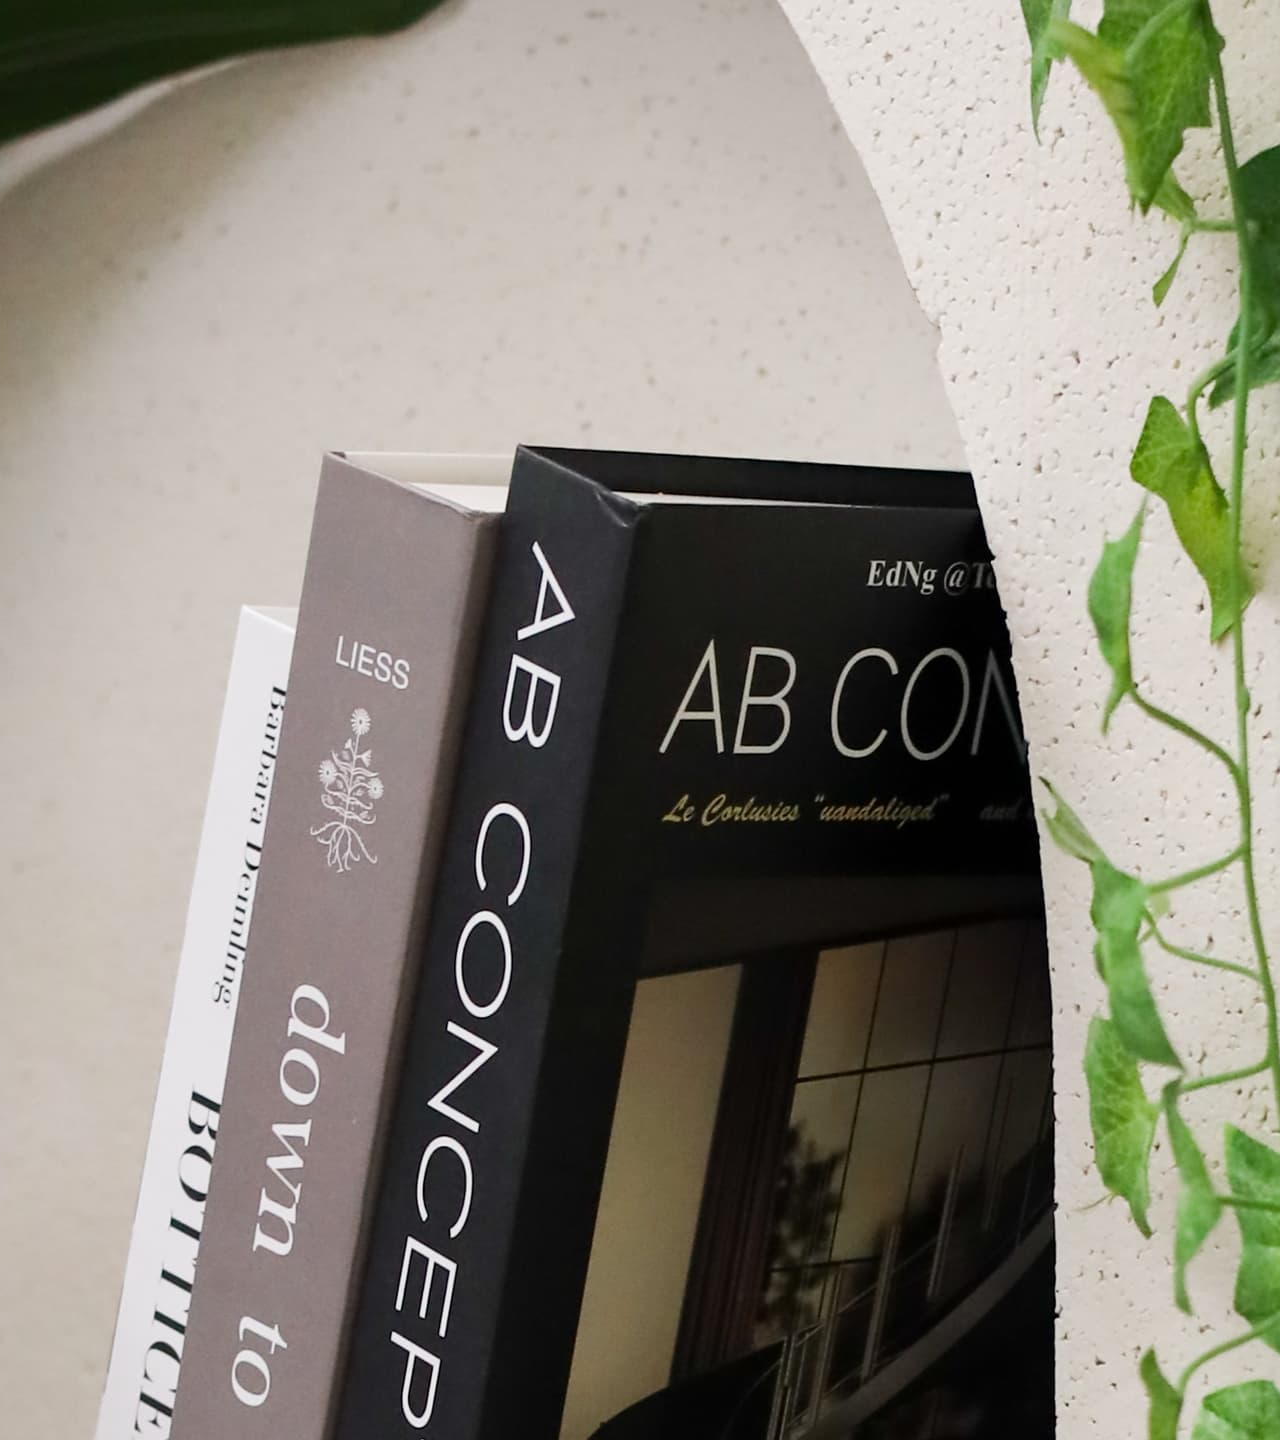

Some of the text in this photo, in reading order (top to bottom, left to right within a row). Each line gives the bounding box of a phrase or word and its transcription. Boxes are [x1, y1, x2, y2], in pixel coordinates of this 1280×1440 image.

[866, 560, 938, 595] EdNg
[334, 635, 411, 690] LIESS
[503, 540, 576, 749] AB
[658, 638, 798, 755] AB
[212, 685, 287, 1010] Barbara Deimling
[662, 792, 696, 824] Le
[252, 983, 347, 1257] down
[231, 1315, 288, 1408] to
